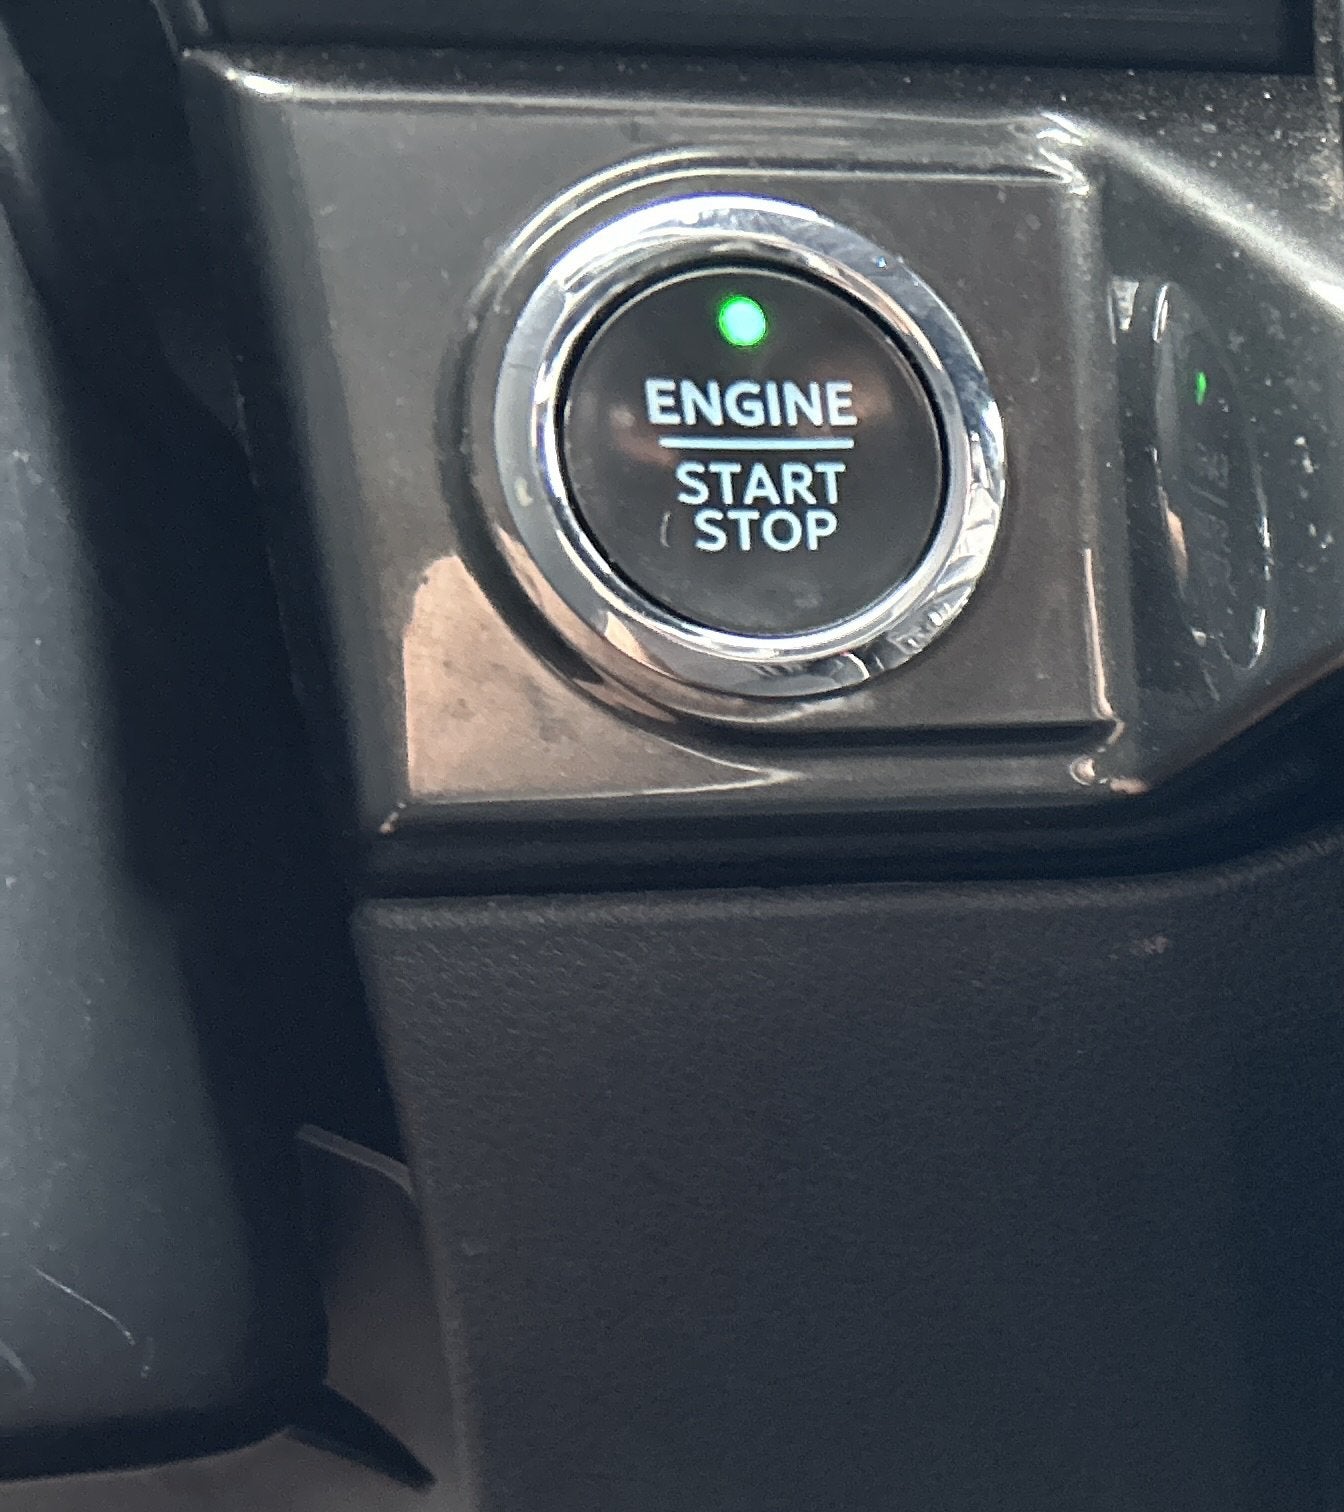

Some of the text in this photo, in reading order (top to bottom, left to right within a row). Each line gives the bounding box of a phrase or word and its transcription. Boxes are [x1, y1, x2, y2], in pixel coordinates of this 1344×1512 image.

[644, 378, 859, 427] ENGINE
[675, 461, 846, 505] START
[694, 508, 838, 552] STOP
